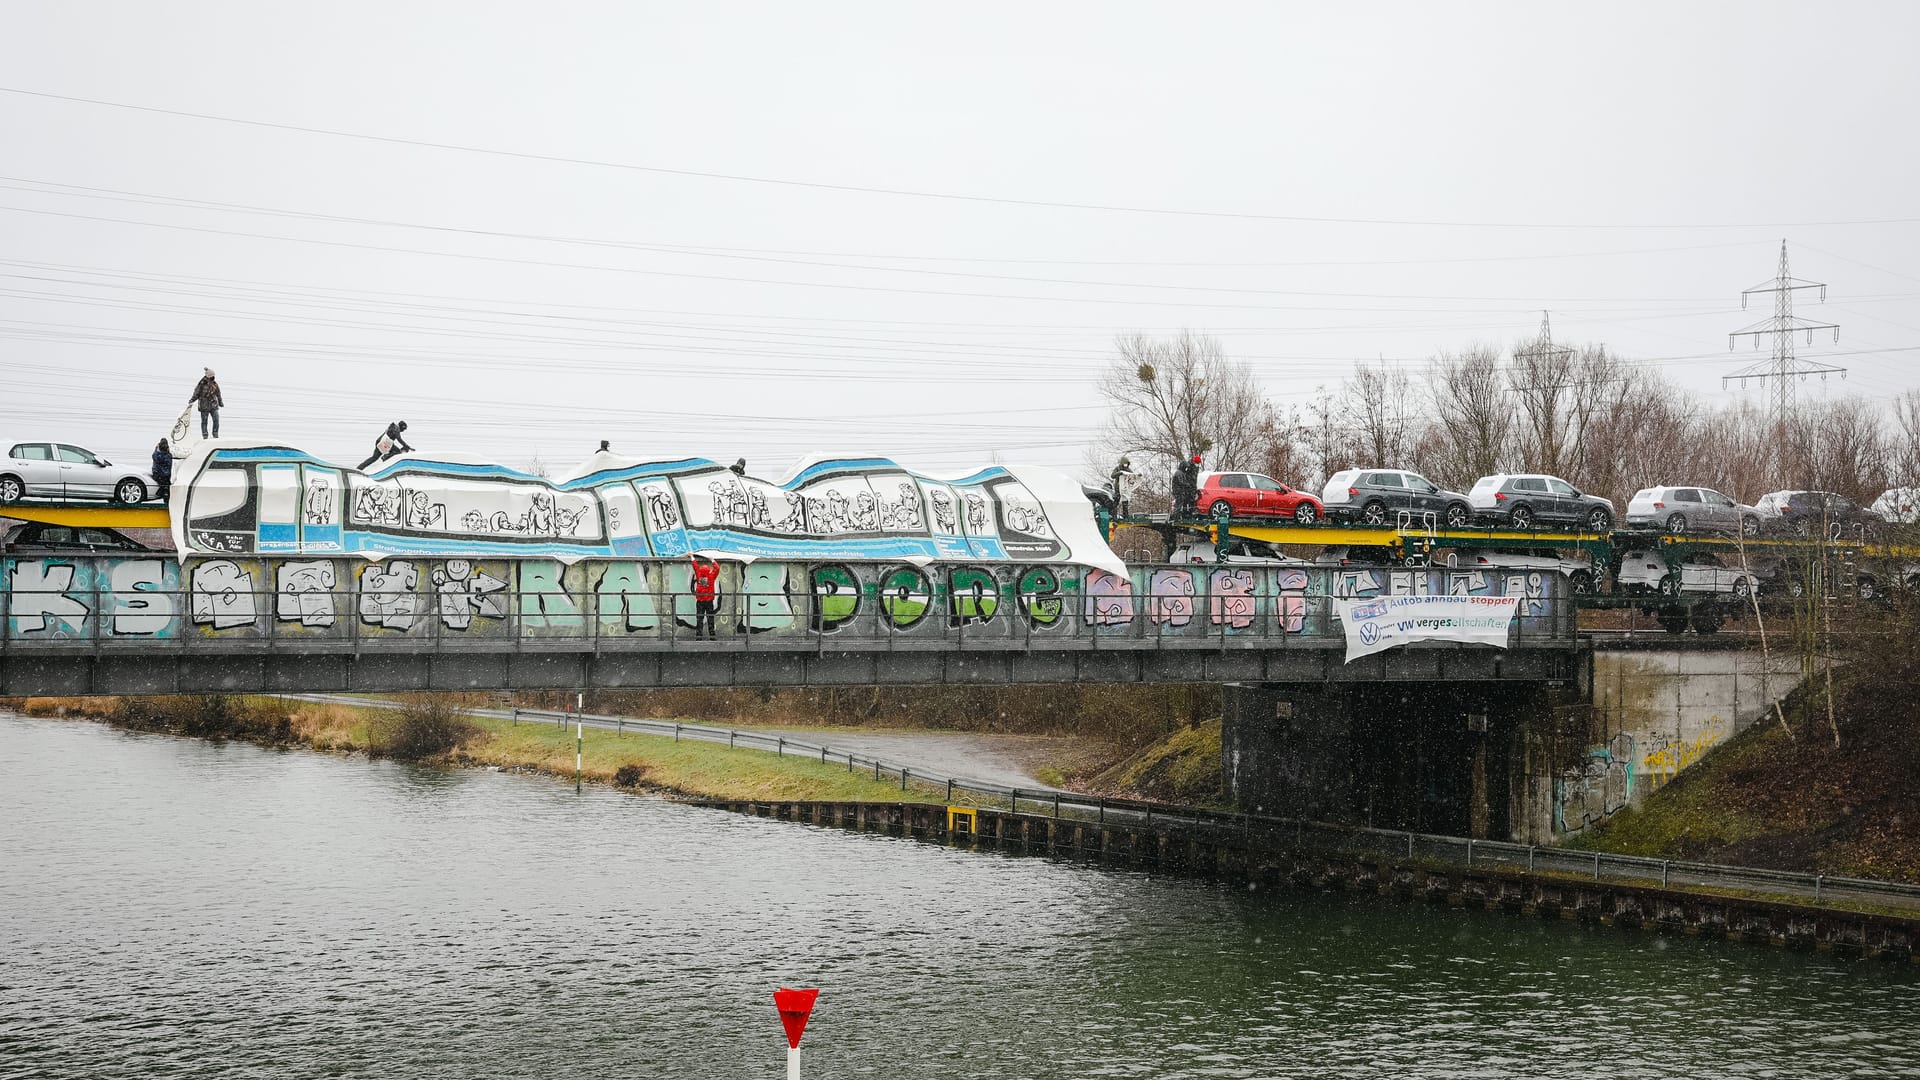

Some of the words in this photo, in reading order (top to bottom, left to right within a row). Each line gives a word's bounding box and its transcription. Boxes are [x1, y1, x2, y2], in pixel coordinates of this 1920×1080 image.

[1470, 596, 1515, 606] stoppen
[1397, 619, 1414, 632] VW
[1416, 617, 1507, 630] vergesellschaften
